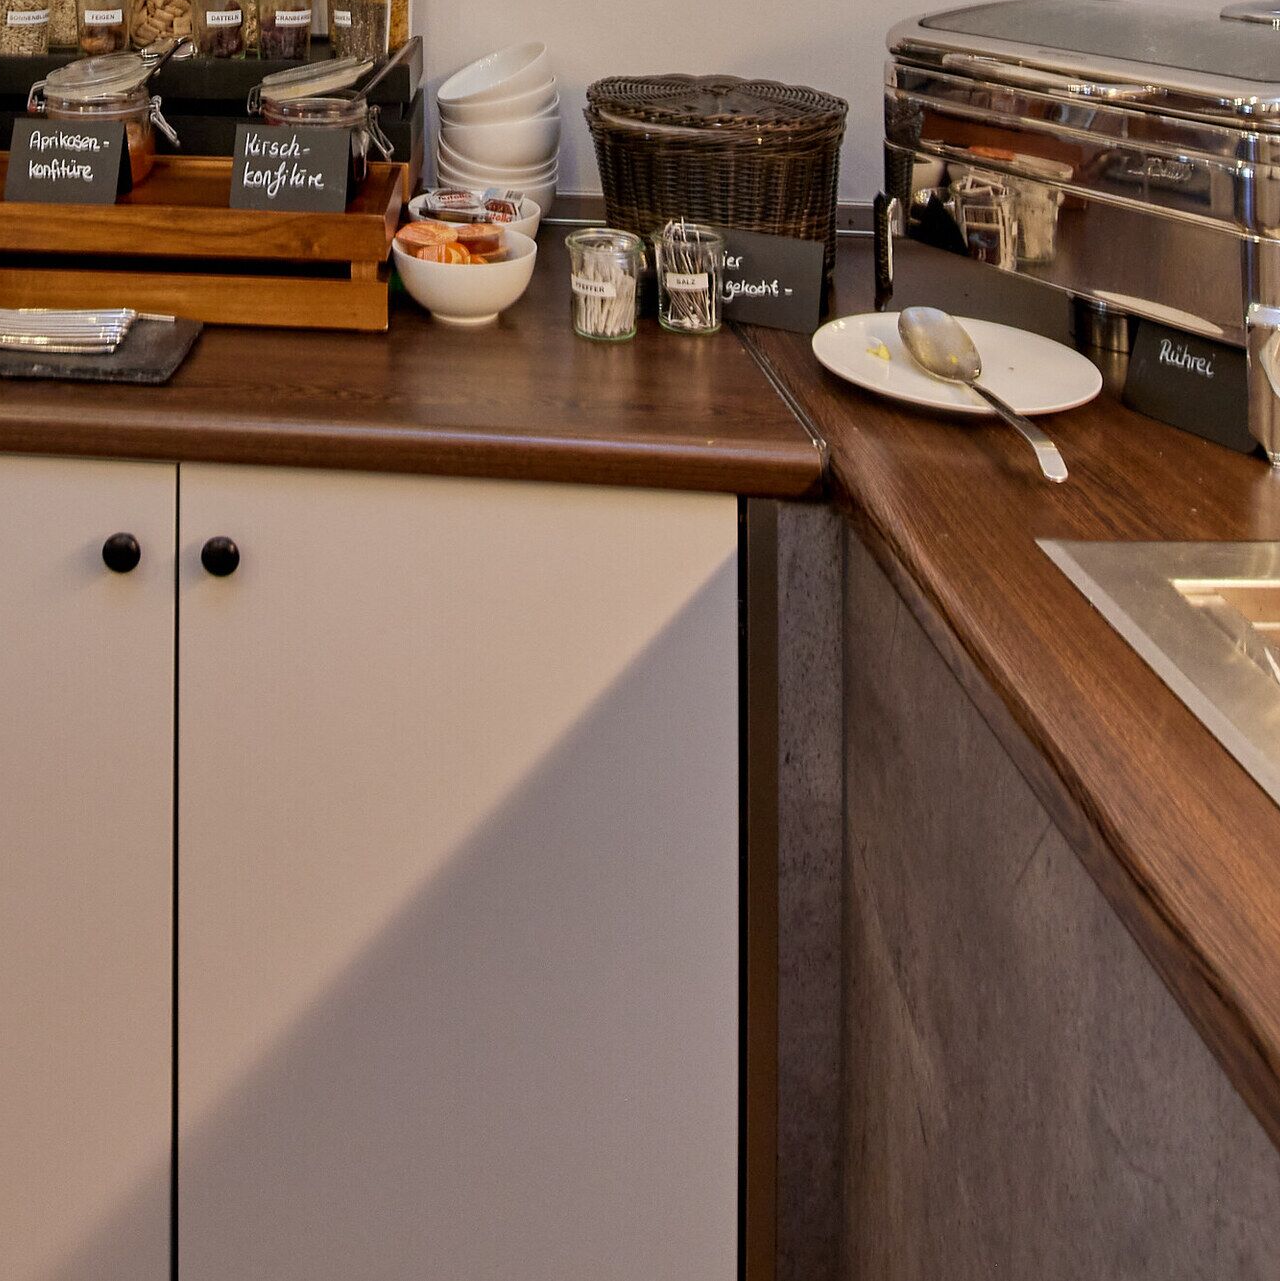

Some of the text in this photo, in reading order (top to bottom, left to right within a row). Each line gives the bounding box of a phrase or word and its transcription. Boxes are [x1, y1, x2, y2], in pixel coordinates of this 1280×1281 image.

[90, 13, 116, 21] FEIGEN
[210, 13, 241, 22] DATTELN
[28, 129, 111, 152] Aprikosen-
[243, 132, 312, 158] Kirsch-
[28, 158, 95, 183] konfitüre
[721, 250, 744, 269] ier
[676, 278, 697, 287] SALZ
[1159, 338, 1217, 378] Rührei
